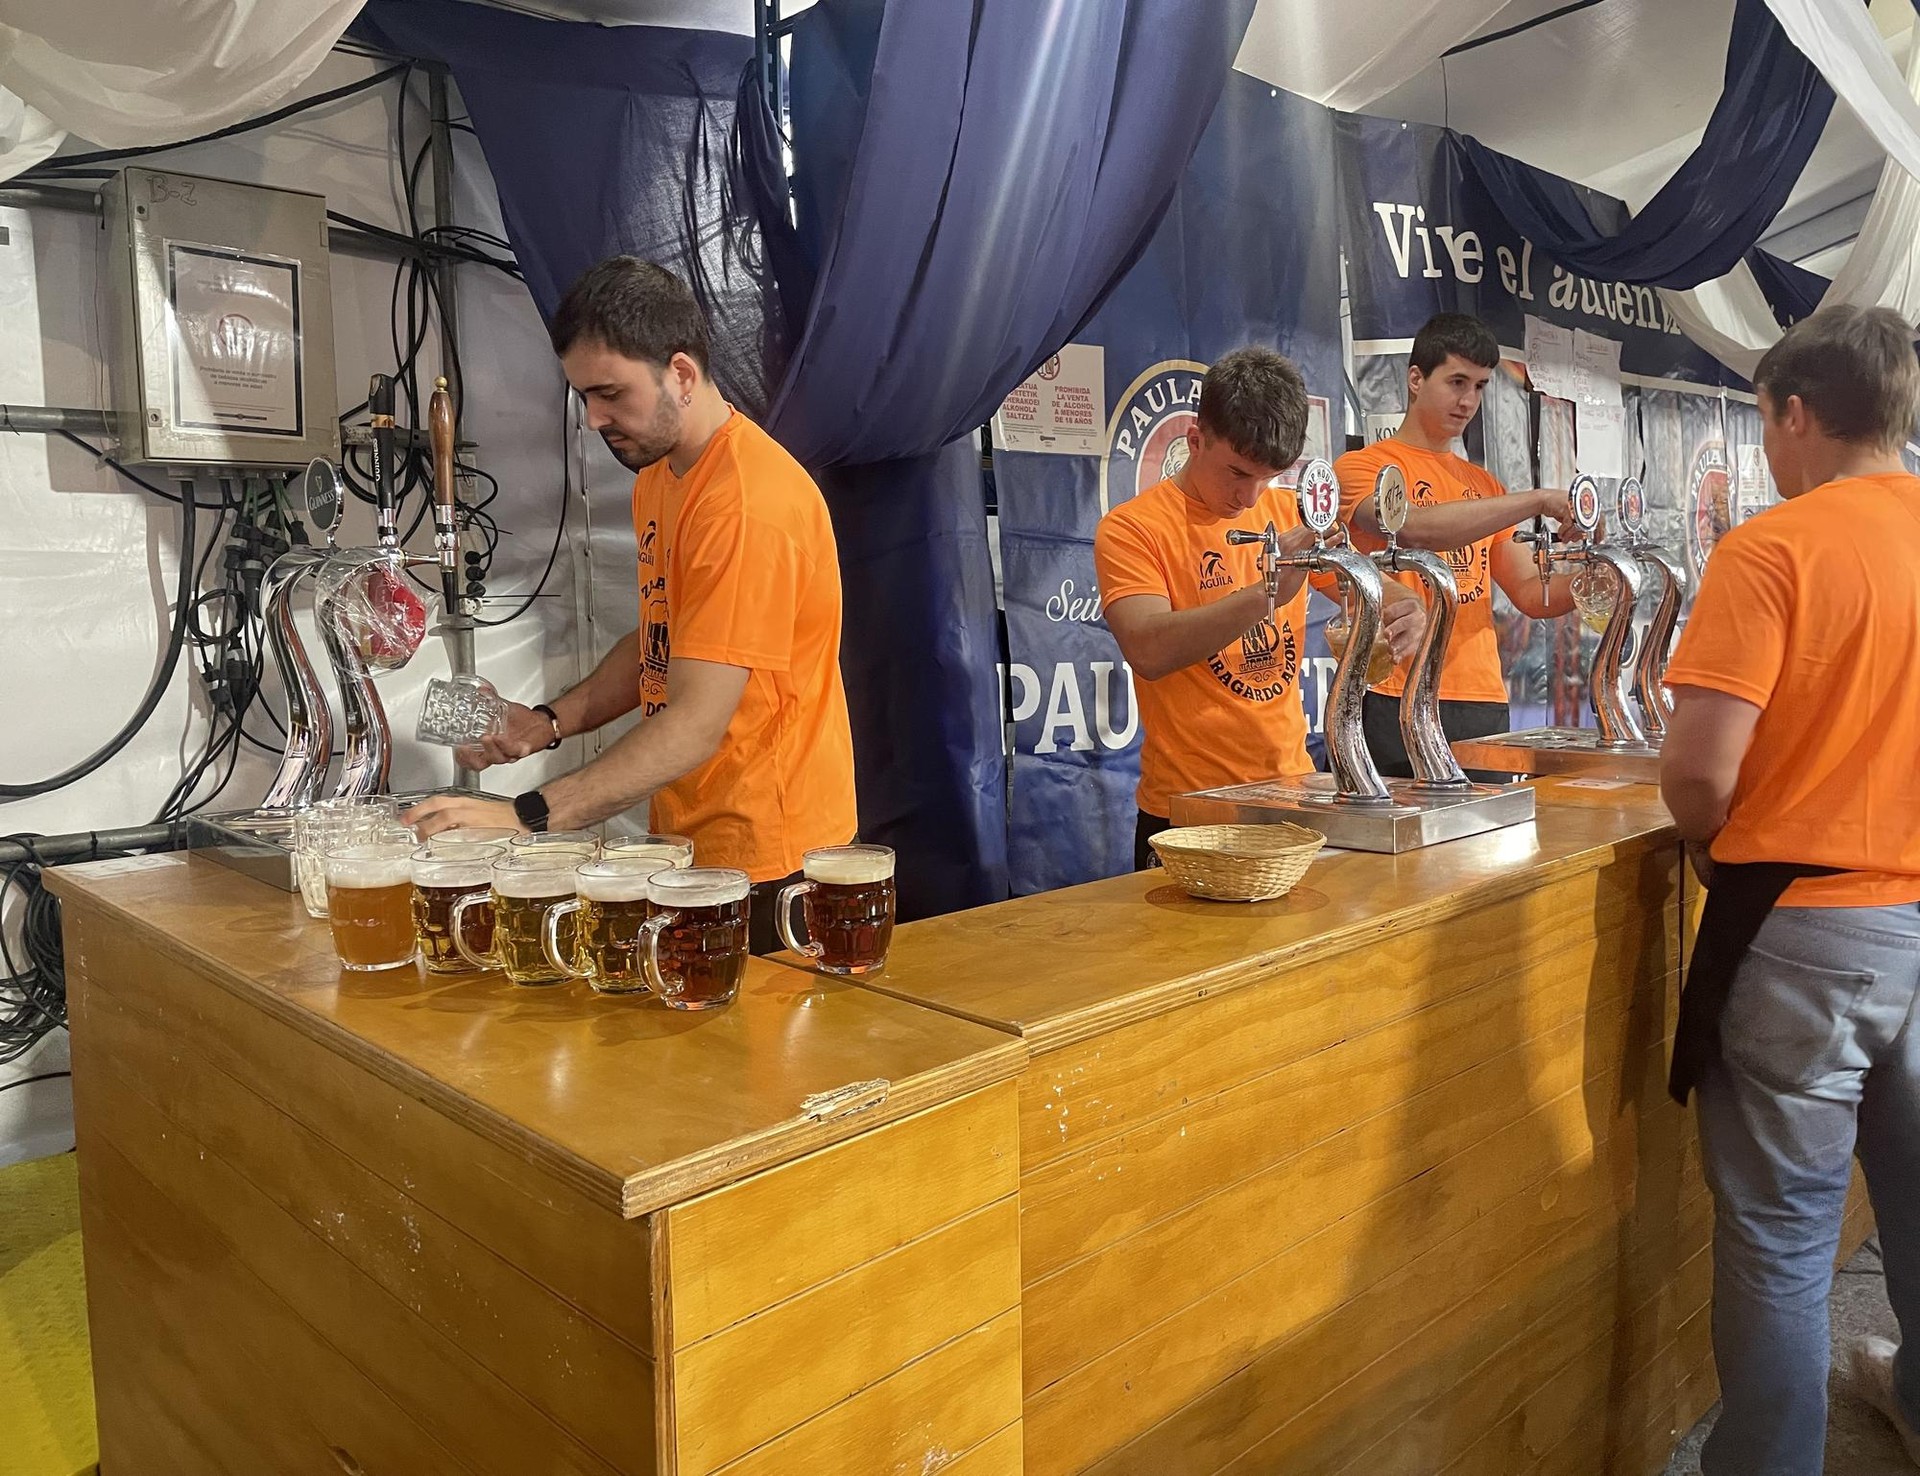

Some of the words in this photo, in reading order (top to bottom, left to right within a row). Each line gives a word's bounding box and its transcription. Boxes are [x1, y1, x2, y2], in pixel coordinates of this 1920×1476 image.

[1373, 202, 1484, 284] Vive
[1497, 236, 1534, 301] el
[1548, 264, 1682, 335] auten
[1054, 385, 1091, 395] PROHIBIDA
[1057, 393, 1066, 401] LA
[1067, 394, 1089, 402] VENTA
[1002, 403, 1038, 414] ALKOHOLA
[1051, 400, 1061, 408] DE
[1063, 402, 1095, 411] ALCOHOL
[1006, 411, 1035, 421] SALTZEA
[1054, 416, 1064, 424] DE
[1073, 416, 1093, 425] AÑOS
[1060, 409, 1092, 418] MENORES
[1116, 377, 1203, 461] PAULA
[1311, 483, 1333, 514] 13
[1311, 511, 1333, 525] LAGER
[1200, 575, 1234, 591] AGUILA
[1046, 579, 1103, 623] Seit
[1281, 619, 1297, 687] AZOKA
[996, 662, 1141, 757] PAU
